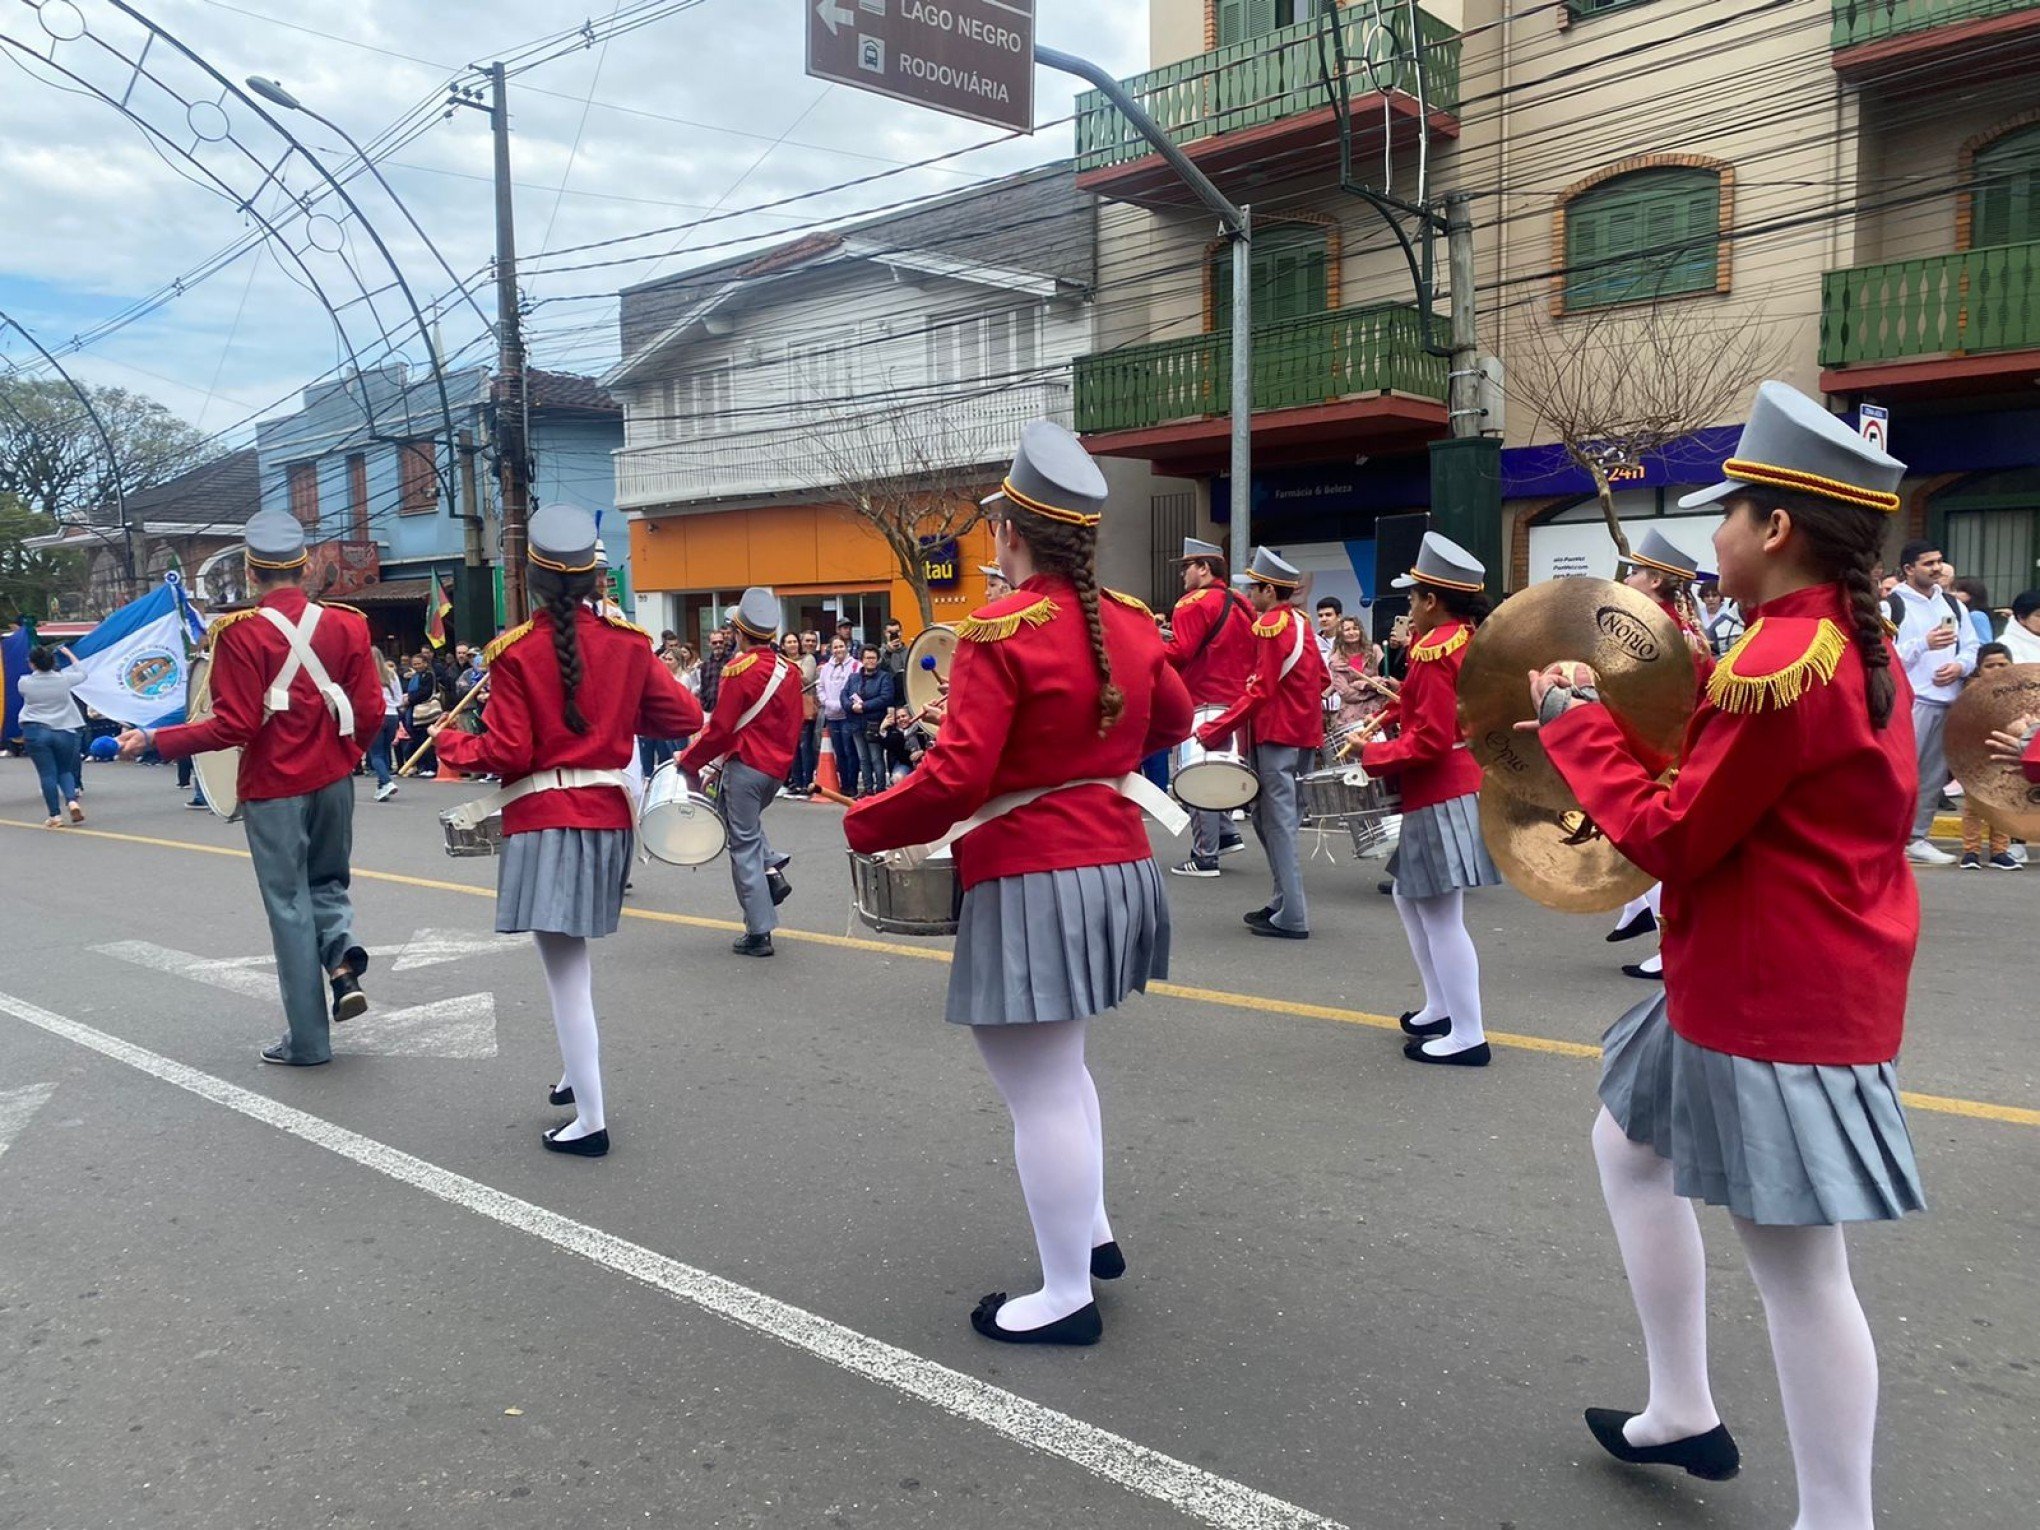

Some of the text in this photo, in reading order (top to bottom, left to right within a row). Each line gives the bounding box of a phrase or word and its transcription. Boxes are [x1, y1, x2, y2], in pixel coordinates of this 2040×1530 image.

[901, 0, 1021, 53] LAGO NEGRO
[900, 53, 1010, 103] RODOVIÁRIA
[1275, 483, 1353, 499] Farmácia & Beleza
[922, 559, 953, 580] taú
[1603, 615, 1655, 656] ORION
